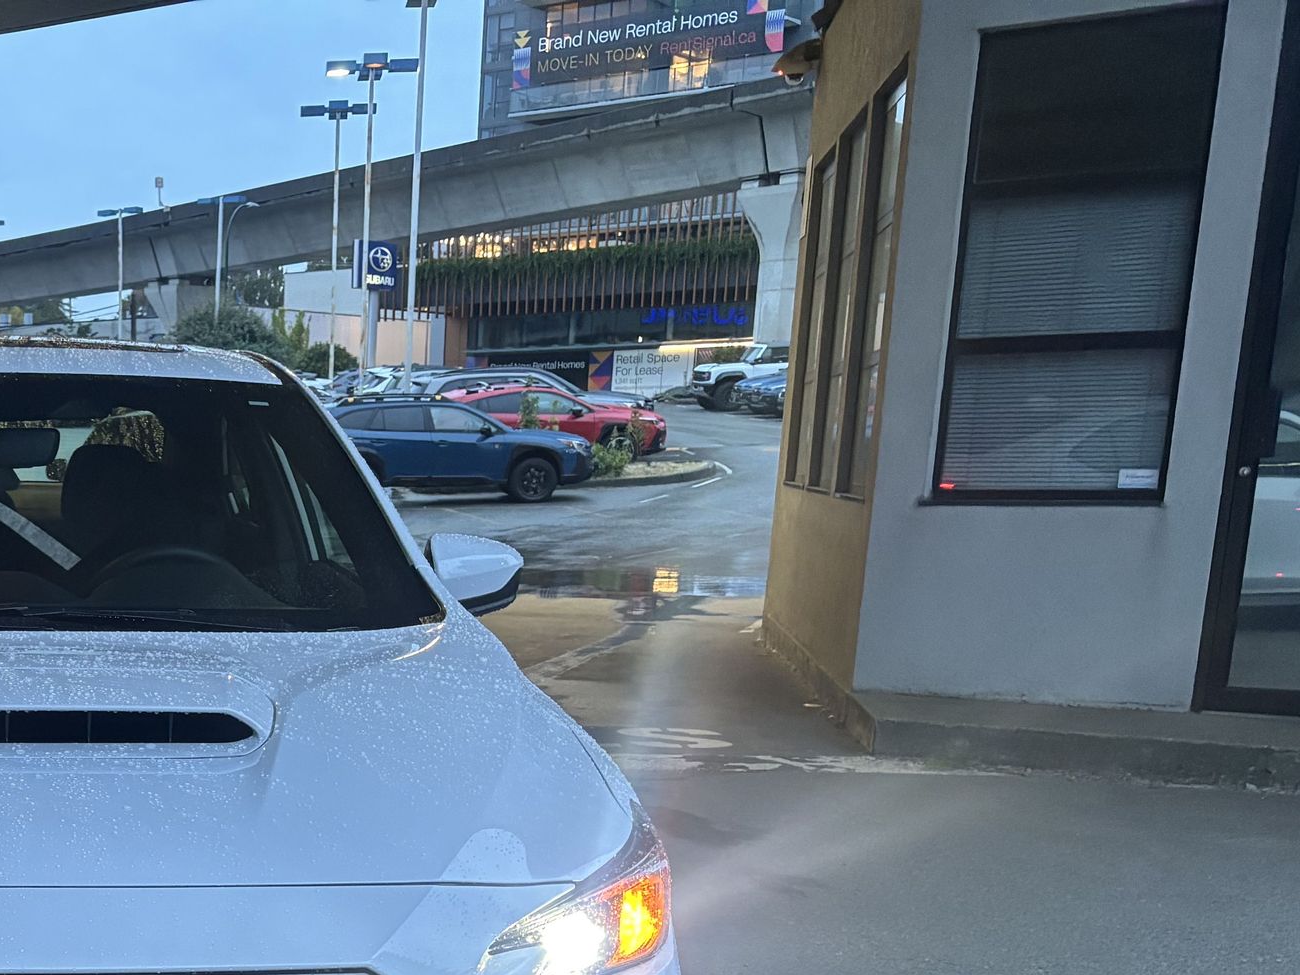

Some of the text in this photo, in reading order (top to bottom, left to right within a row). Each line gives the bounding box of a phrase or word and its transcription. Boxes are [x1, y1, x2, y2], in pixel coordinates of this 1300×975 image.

[538, 10, 738, 53] Brand New Rental Homes
[537, 51, 600, 73] MOVE-IN
[605, 44, 653, 64] TODAY
[366, 273, 395, 286] SUBARU
[557, 360, 586, 369] Homes
[616, 352, 681, 365] Retail Space
[615, 365, 664, 376] For Lease
